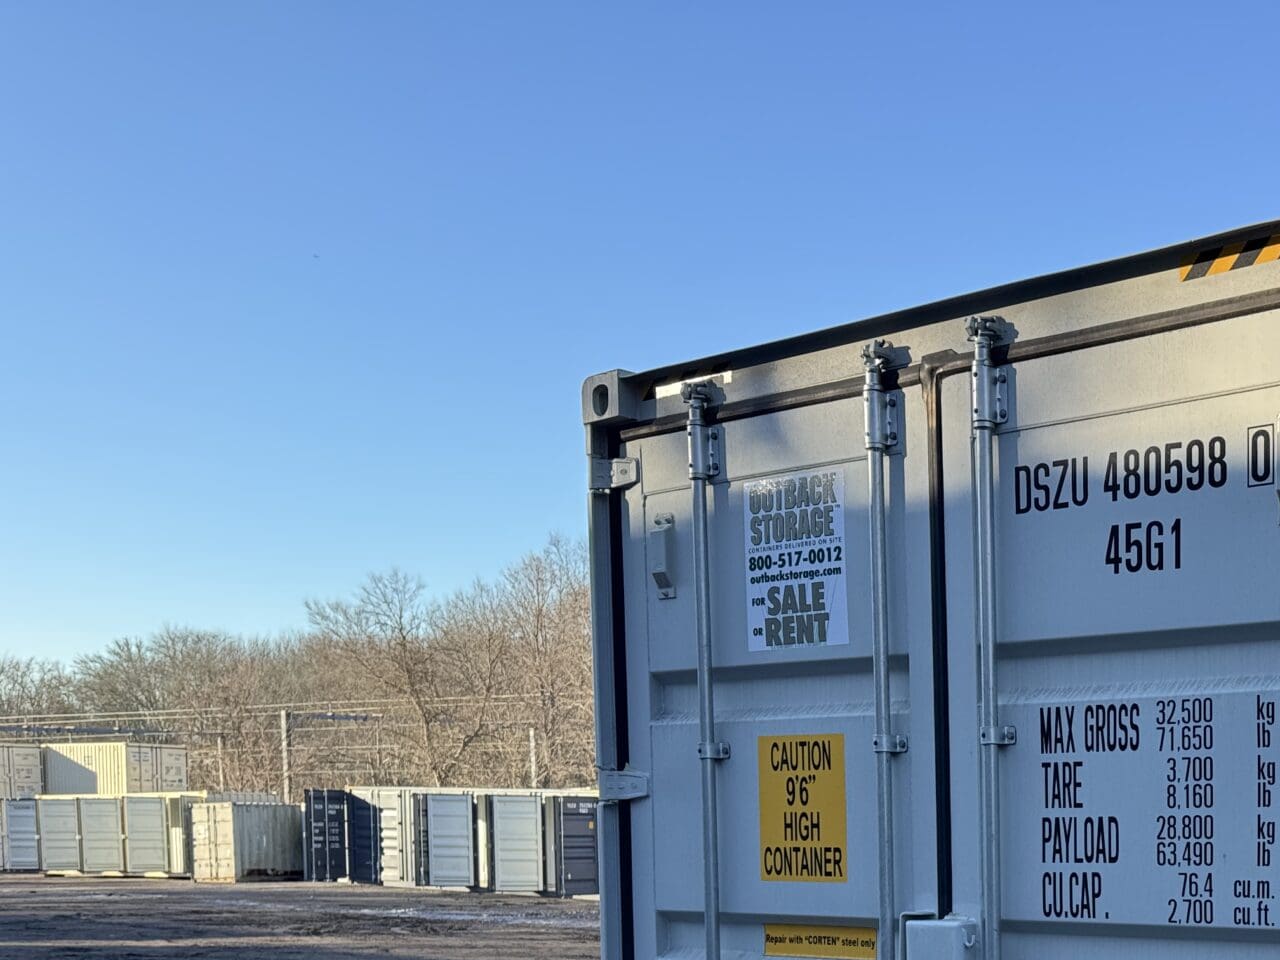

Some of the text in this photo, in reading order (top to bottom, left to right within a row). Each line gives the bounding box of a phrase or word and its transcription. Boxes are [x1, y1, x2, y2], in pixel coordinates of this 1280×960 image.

[1014, 429, 1271, 515] DSZU 480598 0
[749, 473, 837, 515] OUTBACK
[750, 505, 835, 546] STORAGE
[748, 544, 783, 554] CONTAINERS
[784, 539, 816, 549] DELIVERED
[818, 537, 827, 545] ON
[749, 546, 842, 571] 800-517-0012
[1105, 518, 1182, 574] 45G1
[750, 567, 842, 584] outbackstorage.com
[752, 581, 826, 616] FOR SALE
[753, 612, 830, 647] OR RENT
[1040, 695, 1275, 754] MAX GROSS 32,500 kg
[1156, 723, 1271, 752] 71,650 lb
[770, 740, 831, 771] CAUTION
[1041, 755, 1275, 808] TARE 3,700 kg
[1167, 782, 1271, 810] 8,160 lb
[784, 812, 821, 842] HIGH
[1041, 814, 1275, 864] PAYLOAD 28,800 kg
[764, 847, 842, 877] CONTAINER
[1156, 842, 1271, 867] 63,490 lb
[1178, 872, 1213, 898] 76.4
[1233, 879, 1275, 899] cu.m.
[1168, 899, 1275, 926] 2,700 cu.ft.
[765, 934, 787, 945] Repair
[788, 935, 803, 944] with
[841, 938, 859, 947] steel
[861, 938, 876, 950] only
